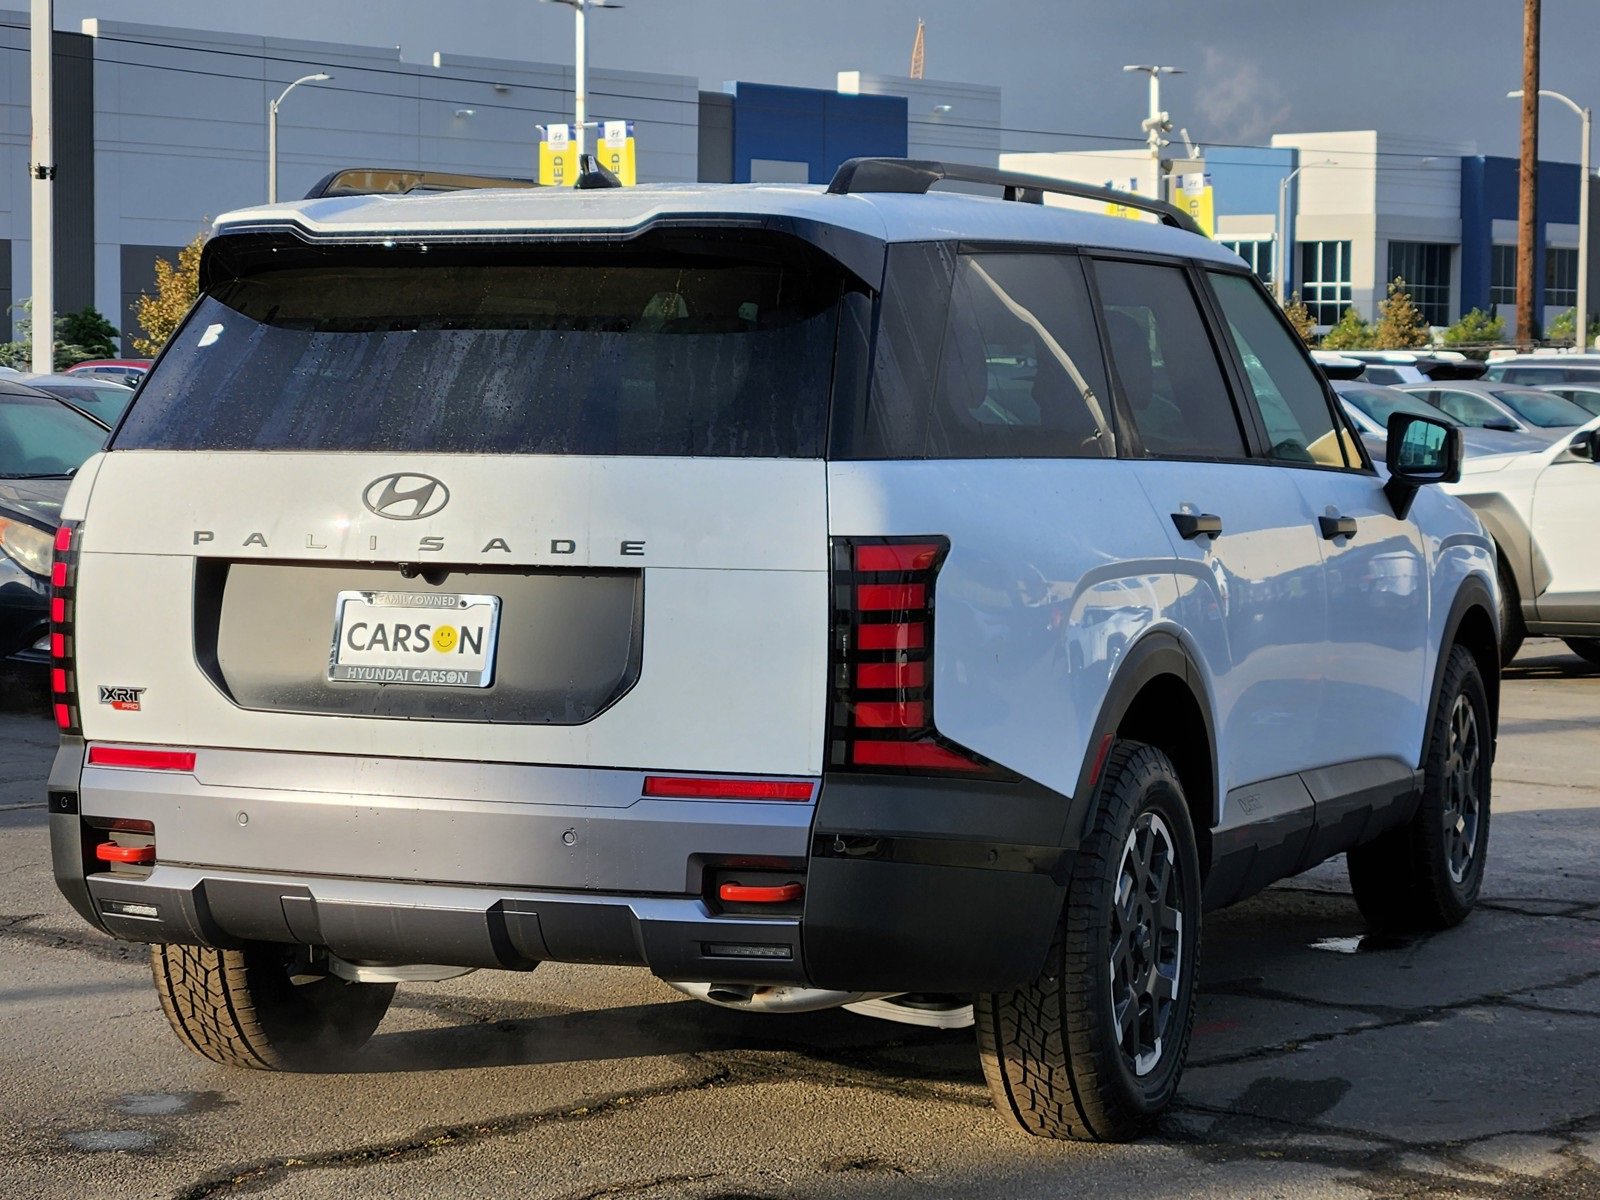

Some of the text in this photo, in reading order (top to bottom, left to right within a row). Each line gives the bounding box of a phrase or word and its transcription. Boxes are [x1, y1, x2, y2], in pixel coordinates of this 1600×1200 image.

[193, 530, 647, 557] PALISADE
[378, 593, 456, 607] FAMILY OWNED
[346, 666, 468, 684] HYUNDAI CARSON
[99, 685, 146, 703] XRT
